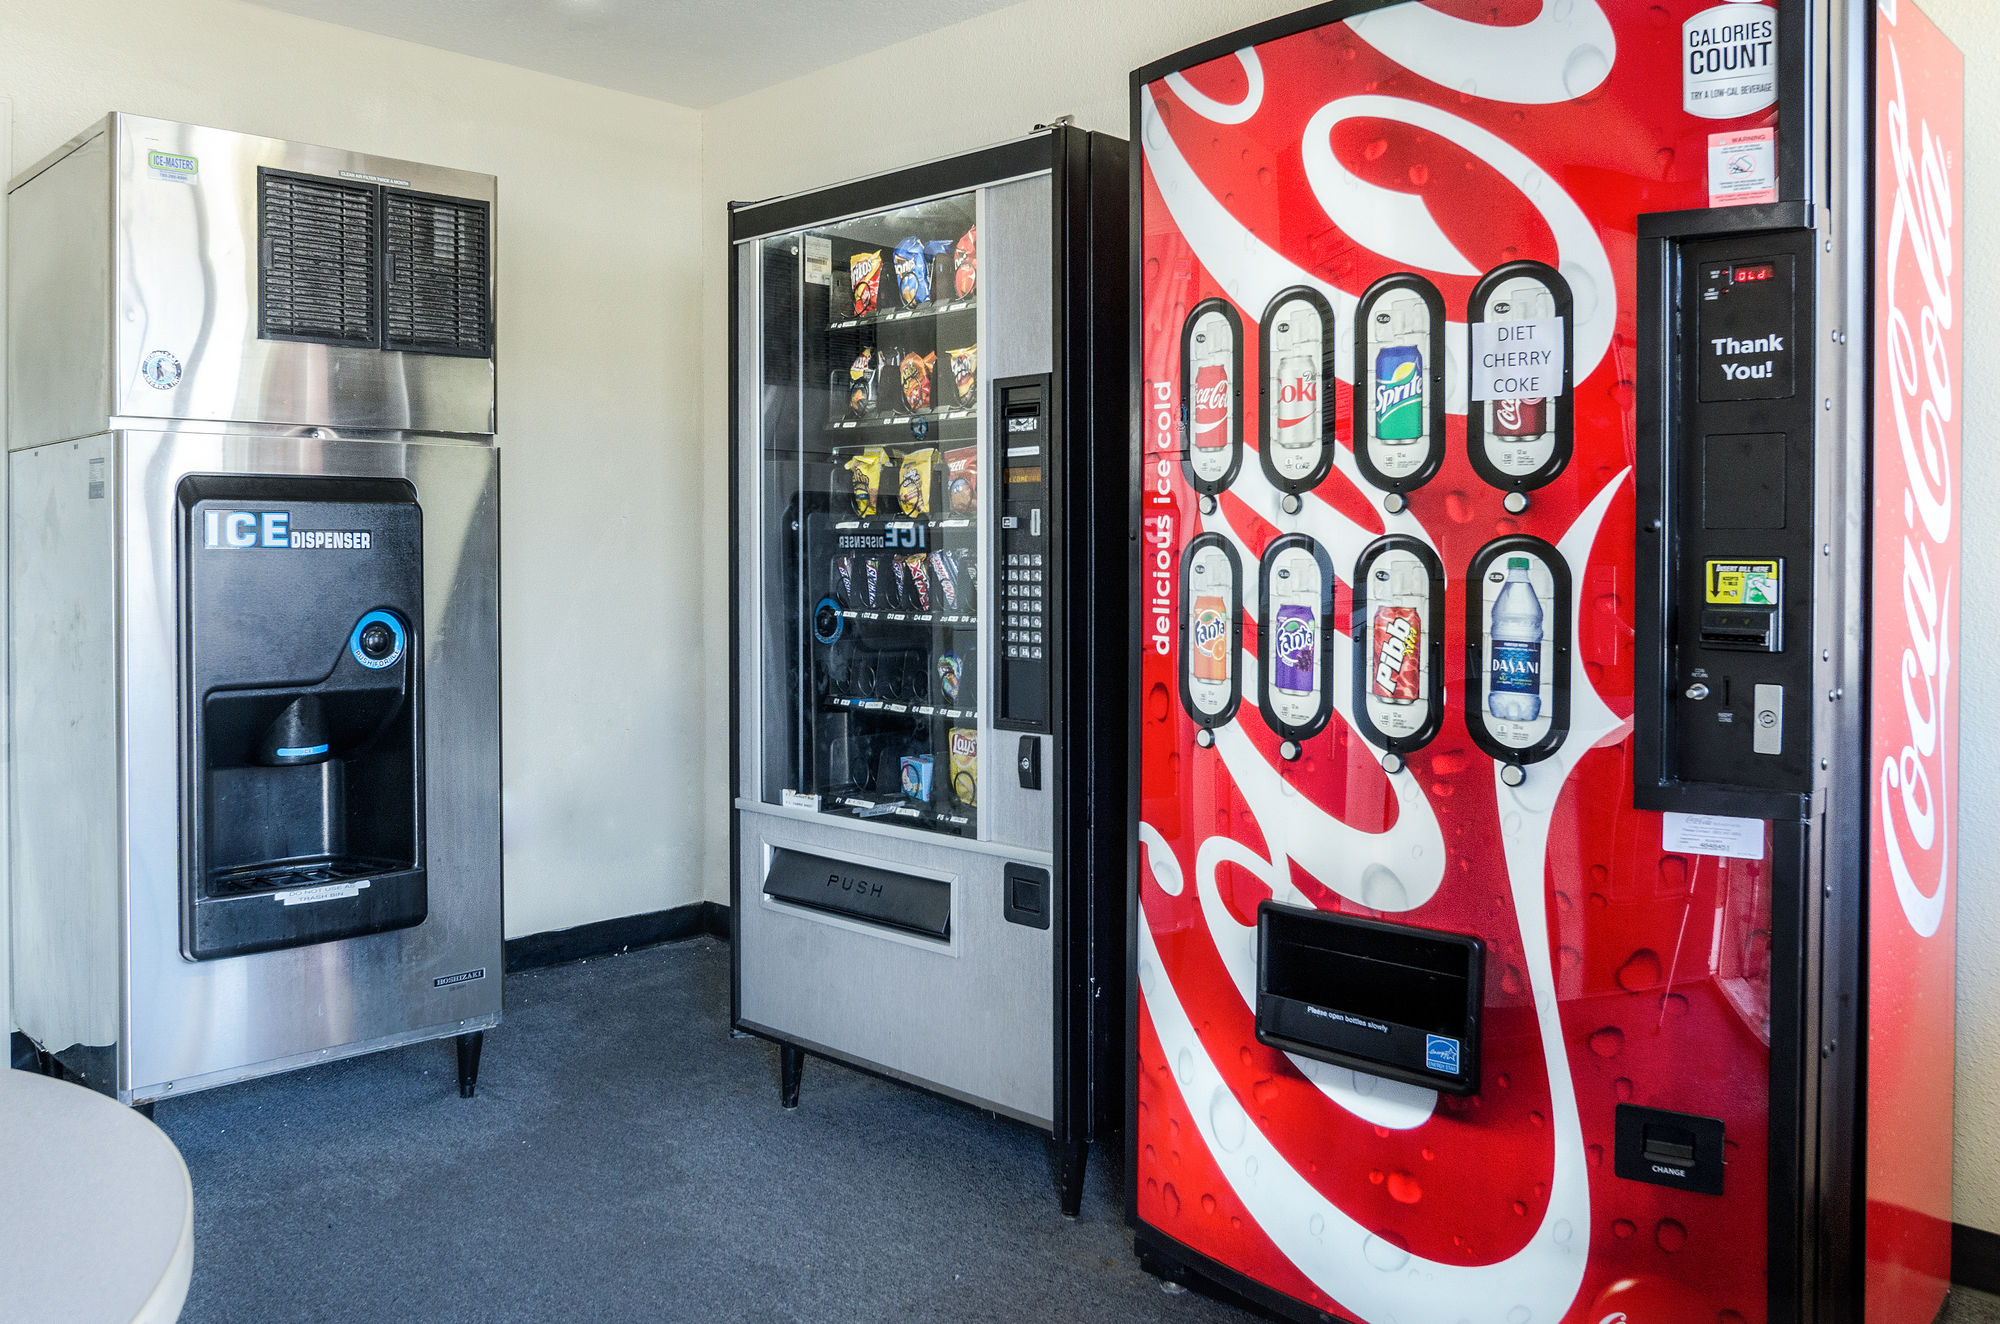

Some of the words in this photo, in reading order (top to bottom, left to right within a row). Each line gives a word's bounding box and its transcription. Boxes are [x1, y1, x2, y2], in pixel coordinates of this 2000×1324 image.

[1690, 21, 1772, 47] CALORIES
[1690, 41, 1772, 74] COUNT
[1691, 91, 1703, 100] TRY
[1704, 91, 1709, 99] A
[1711, 87, 1738, 99] LOW-CAL
[1741, 83, 1772, 95] BEVERAGE
[1732, 135, 1765, 143] WARNING
[153, 154, 194, 170] ICE-MASTERS
[1498, 325, 1536, 342] DIET
[1711, 333, 1784, 355] Thank
[1483, 351, 1551, 368] CHERRY
[1721, 361, 1773, 380] You!
[1376, 373, 1422, 415] Sprite
[1494, 377, 1540, 393] COKE
[1153, 381, 1171, 449] cold
[1153, 459, 1171, 504] ice
[205, 511, 290, 548] ICE
[291, 531, 371, 549] DISPENSER
[1716, 564, 1738, 572] INSERT
[1152, 515, 1171, 655] delicious
[355, 649, 373, 666] PUSH
[374, 659, 389, 667] FOR
[1376, 617, 1412, 695] Pibb
[1493, 657, 1539, 675] DASANI
[827, 874, 883, 898] PUSH
[436, 971, 482, 985] HOSHIZAKI
[1307, 1006, 1327, 1017] Please
[1328, 1012, 1344, 1022] open
[1345, 1015, 1367, 1027] bottles
[1368, 1021, 1388, 1033] slowly
[1428, 1061, 1445, 1069] ENERGY
[1446, 1064, 1457, 1072] STAR
[1651, 1165, 1686, 1177] CHANGE
